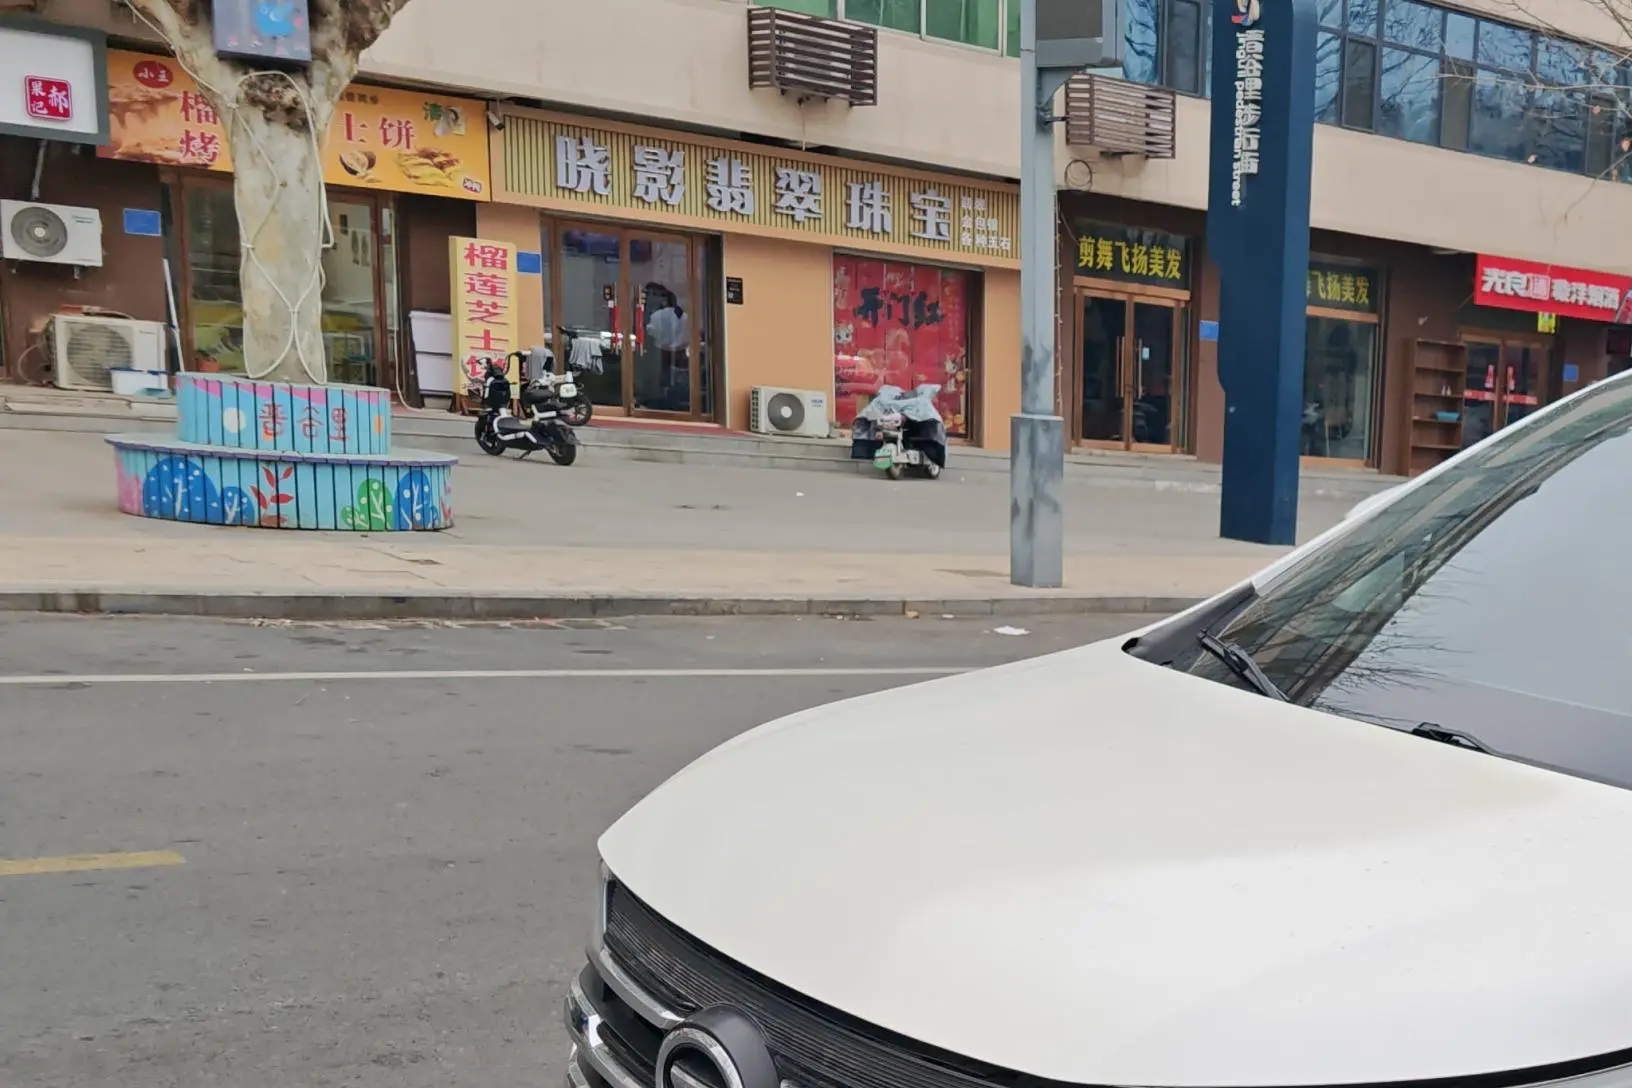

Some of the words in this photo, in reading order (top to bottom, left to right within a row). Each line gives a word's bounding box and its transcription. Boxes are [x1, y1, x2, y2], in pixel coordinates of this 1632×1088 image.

[554, 134, 952, 242] 晓影翡翠珠宝
[1231, 161, 1242, 206] street
[1077, 234, 1183, 281] 剪舞飞扬美发
[852, 285, 946, 330] 开门红
